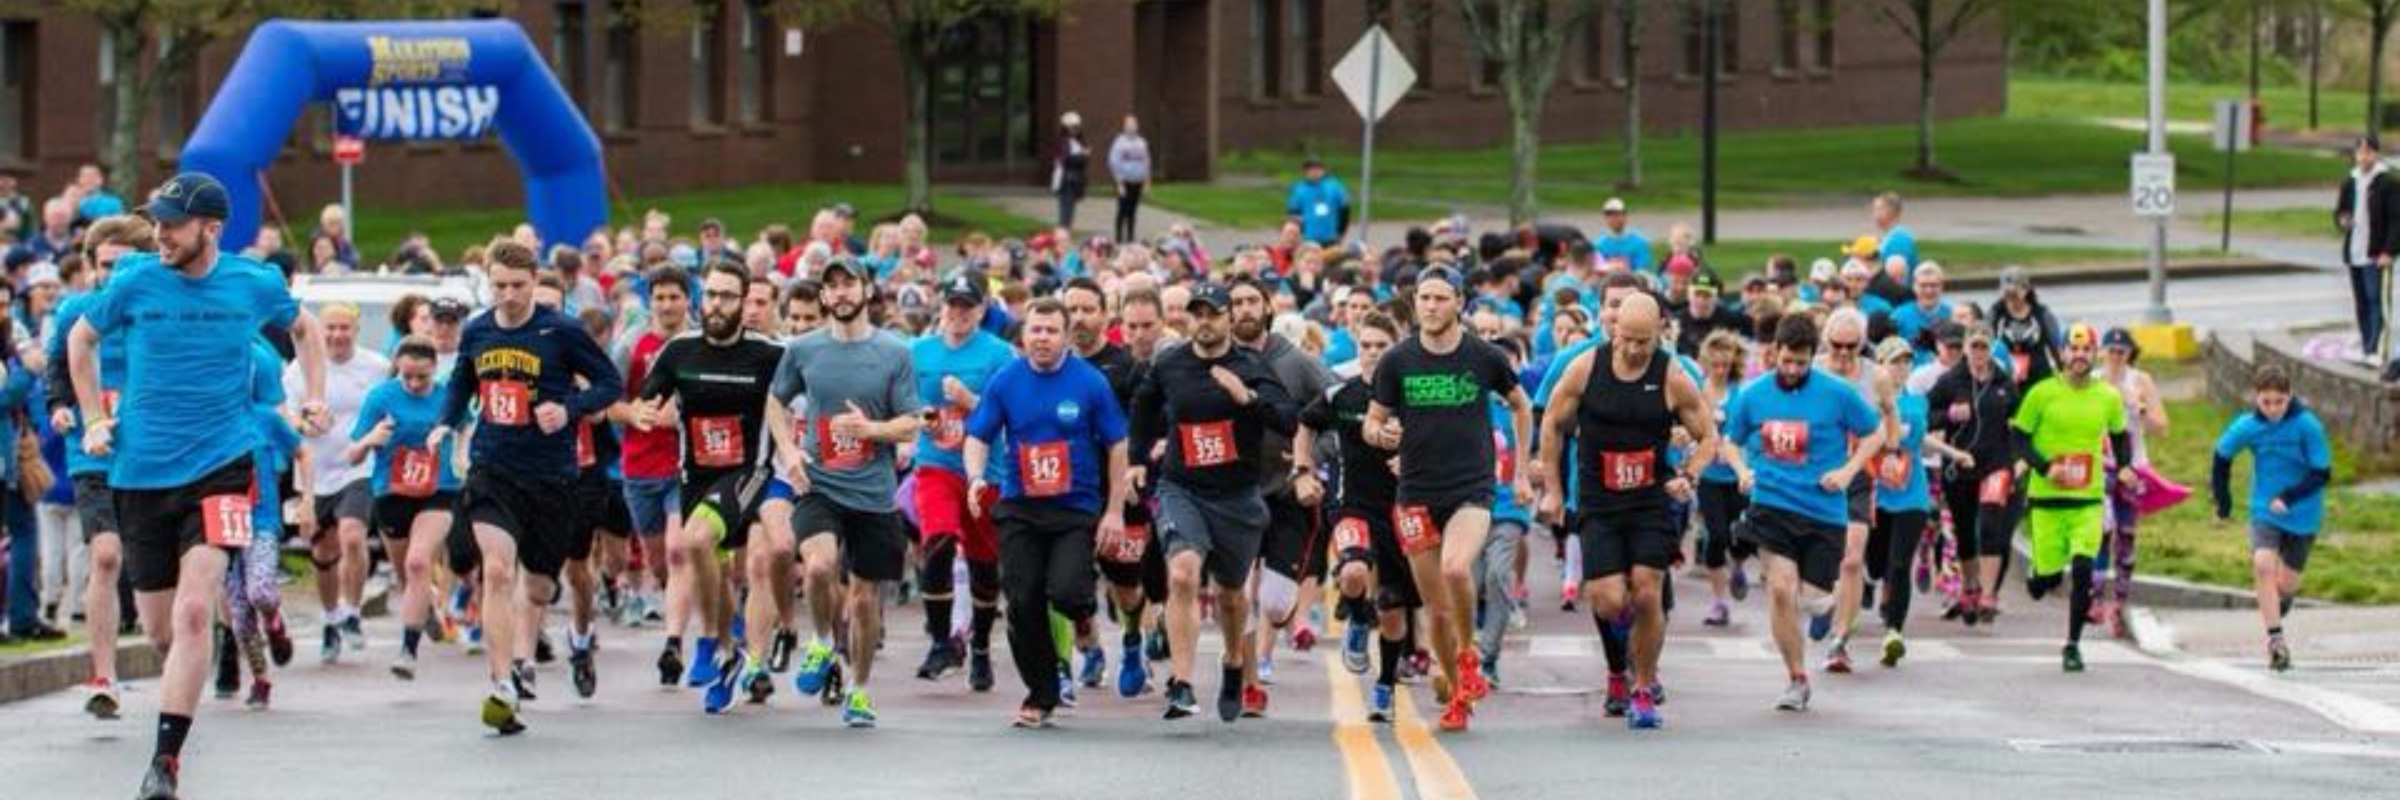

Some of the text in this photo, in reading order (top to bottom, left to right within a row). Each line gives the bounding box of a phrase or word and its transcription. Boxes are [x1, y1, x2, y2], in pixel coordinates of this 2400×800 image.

[336, 86, 499, 137] FINISH
[2136, 186, 2171, 209] 20
[1403, 375, 1456, 387] ROCK
[1030, 456, 1060, 479] 342
